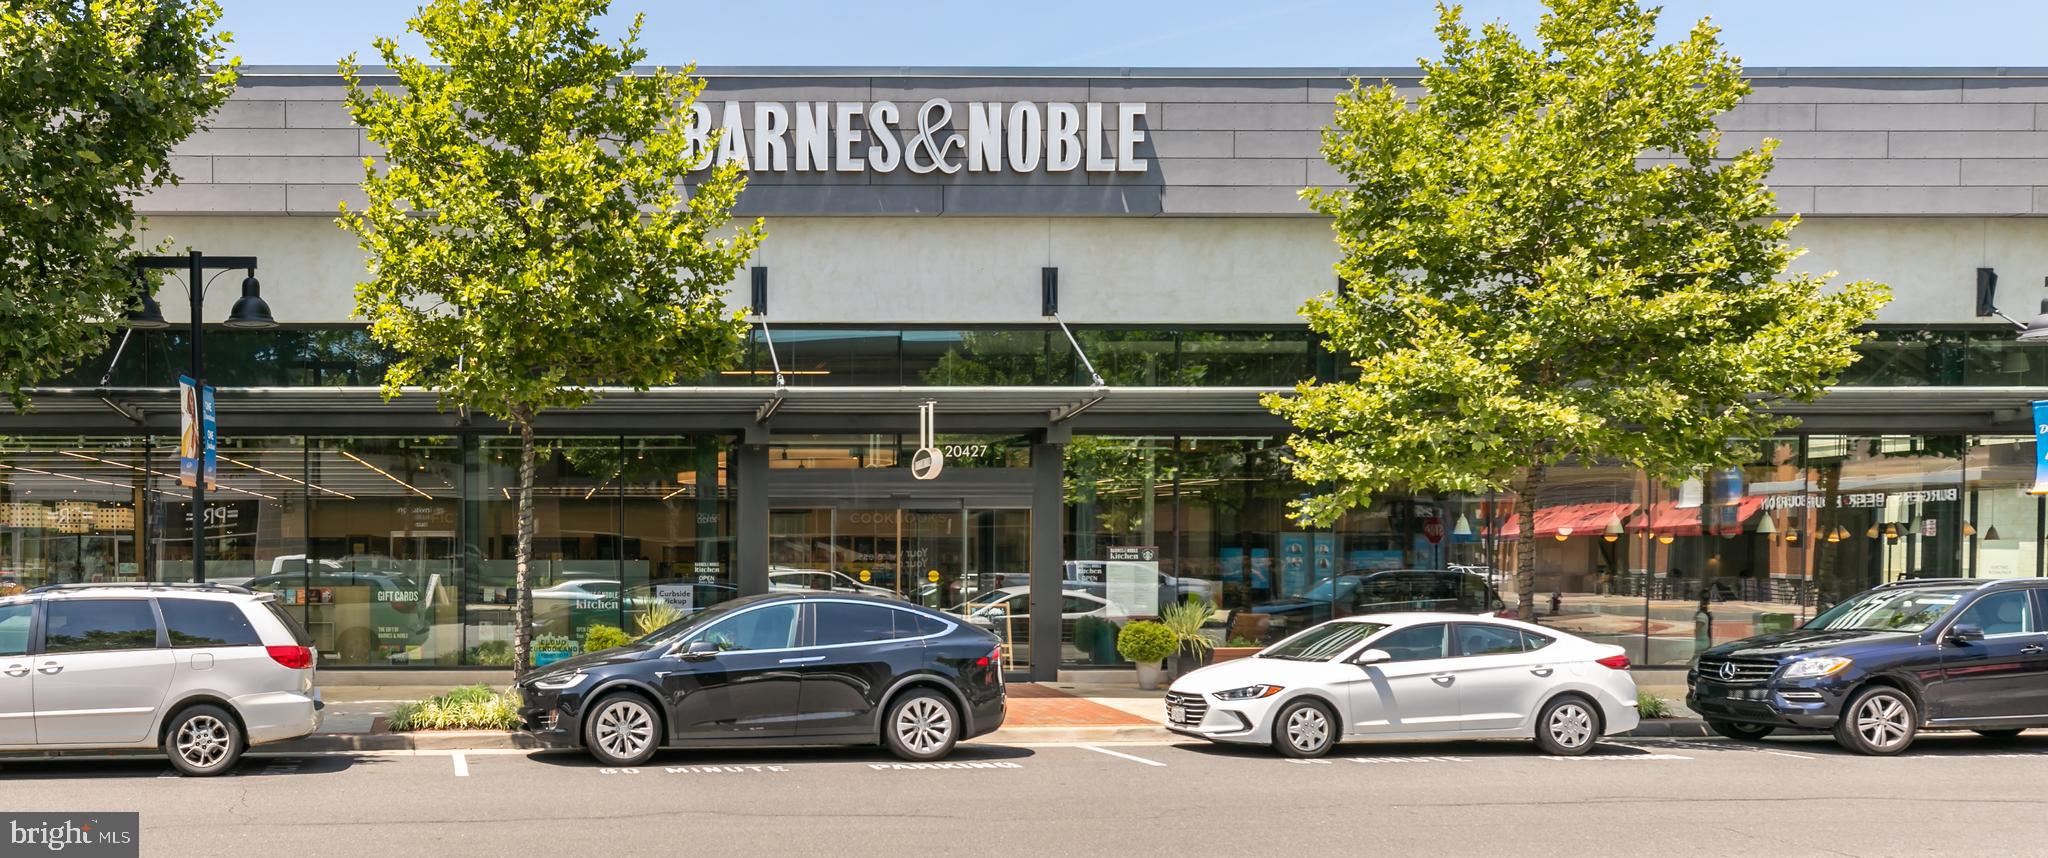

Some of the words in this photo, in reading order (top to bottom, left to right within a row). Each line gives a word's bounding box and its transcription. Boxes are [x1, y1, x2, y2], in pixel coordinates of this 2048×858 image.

[945, 445, 988, 458] 20427
[377, 591, 394, 601] GIFT
[395, 591, 419, 601] CARDS
[576, 599, 619, 609] kitchen
[599, 767, 640, 775] 60
[665, 765, 790, 773] MINUTE
[868, 762, 1023, 770] PARKING
